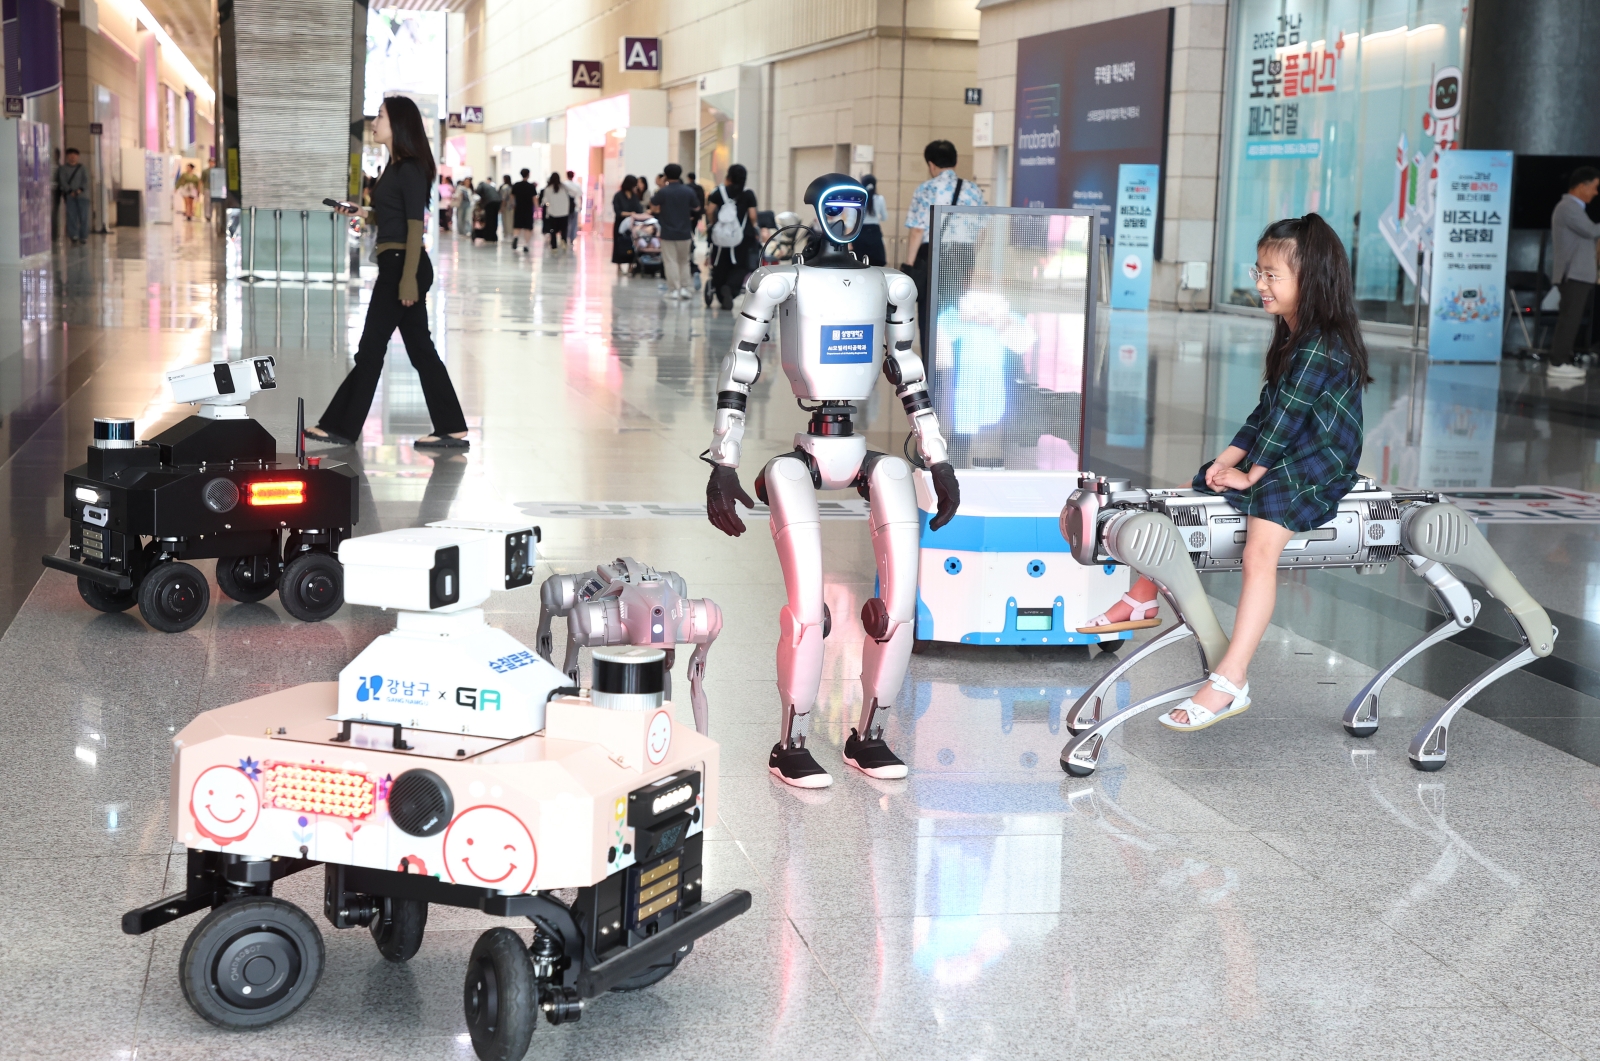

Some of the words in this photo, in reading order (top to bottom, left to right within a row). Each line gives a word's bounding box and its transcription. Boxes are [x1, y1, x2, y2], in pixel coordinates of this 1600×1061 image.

[1277, 12, 1302, 48] 강남
[627, 41, 658, 67] A1
[573, 64, 601, 86] A2
[1250, 50, 1337, 98] 로봇플러스
[465, 107, 483, 123] A3
[1248, 102, 1299, 136] 페스티벌
[1120, 205, 1152, 216] 비즈니스
[1443, 210, 1502, 225] 비즈니스
[1449, 228, 1493, 243] 상담회
[488, 650, 539, 674] 순찰로봇
[387, 679, 430, 697] 강남구
[456, 687, 501, 711] GA
